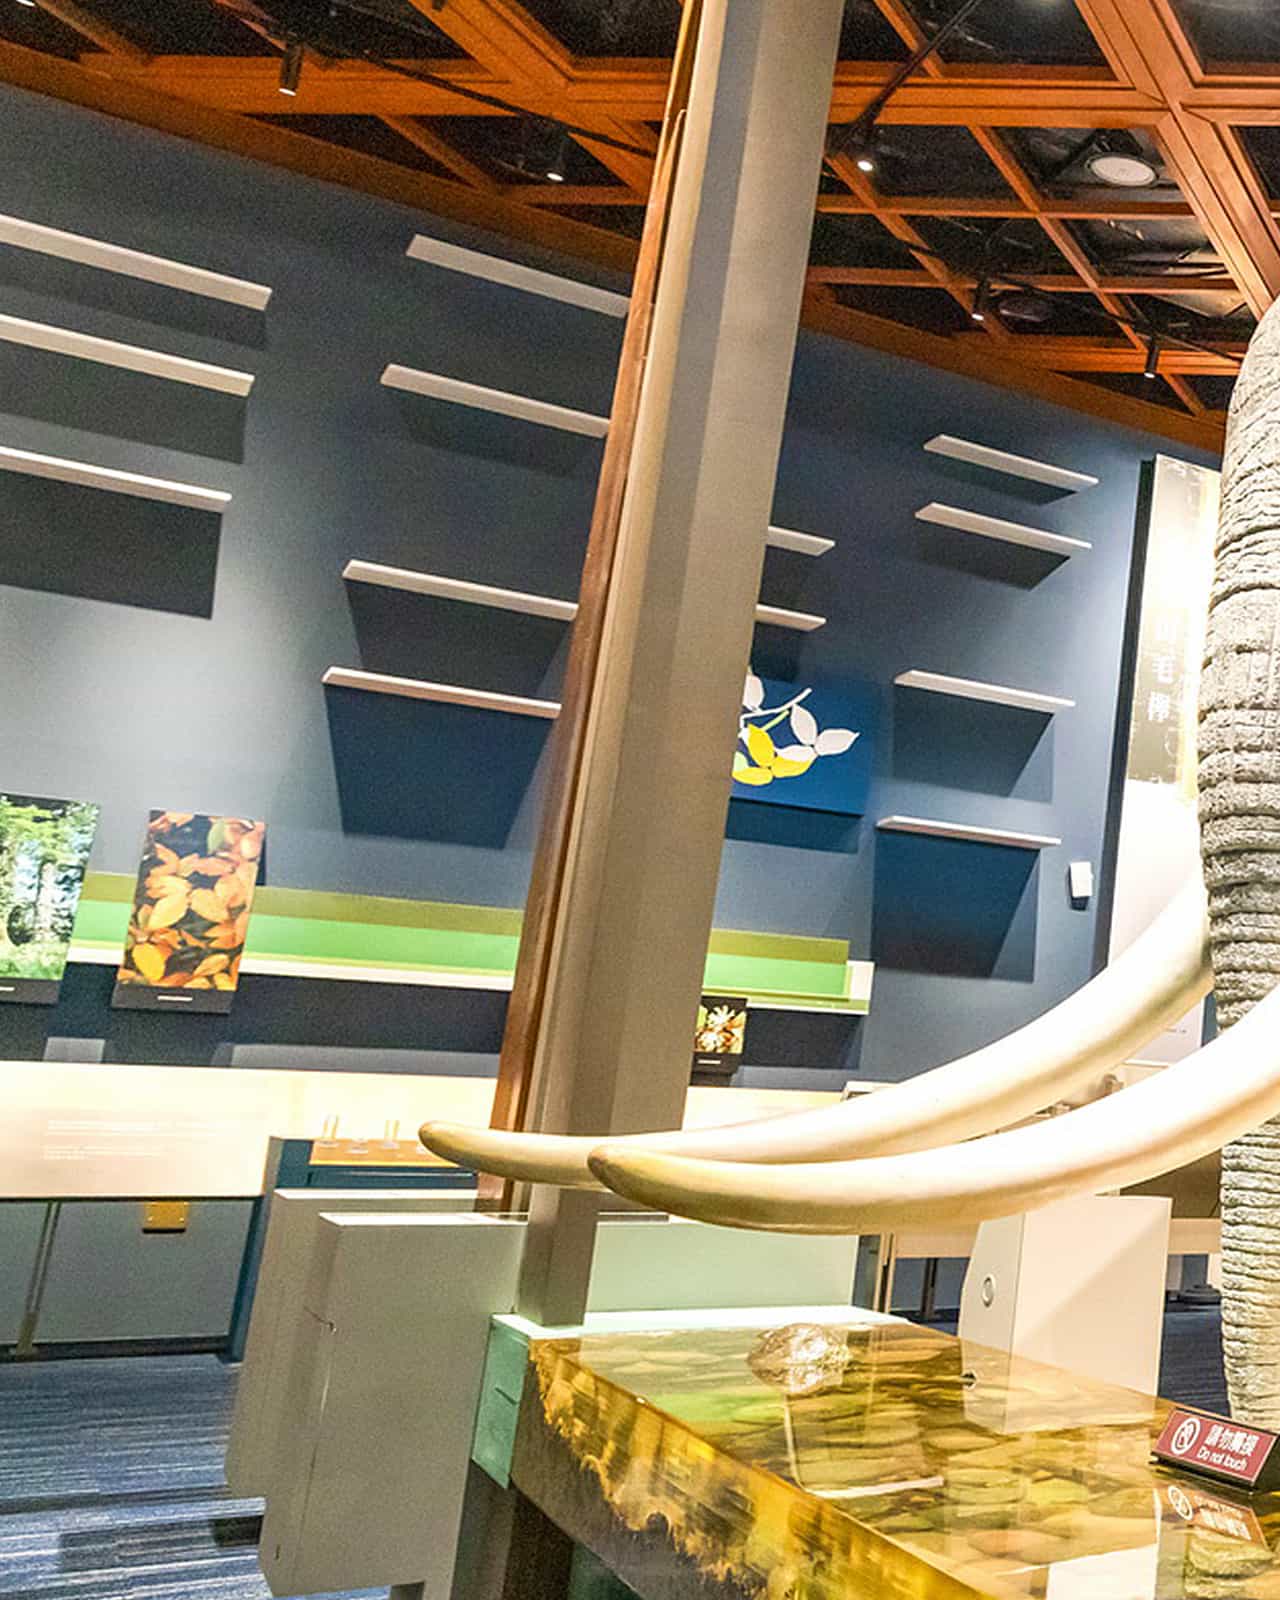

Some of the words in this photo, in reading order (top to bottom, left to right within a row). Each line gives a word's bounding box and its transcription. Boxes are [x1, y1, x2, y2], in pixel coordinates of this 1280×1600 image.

[1197, 1446, 1210, 1460] Do
[1210, 1452, 1225, 1464] not
[1224, 1455, 1248, 1471] touch
